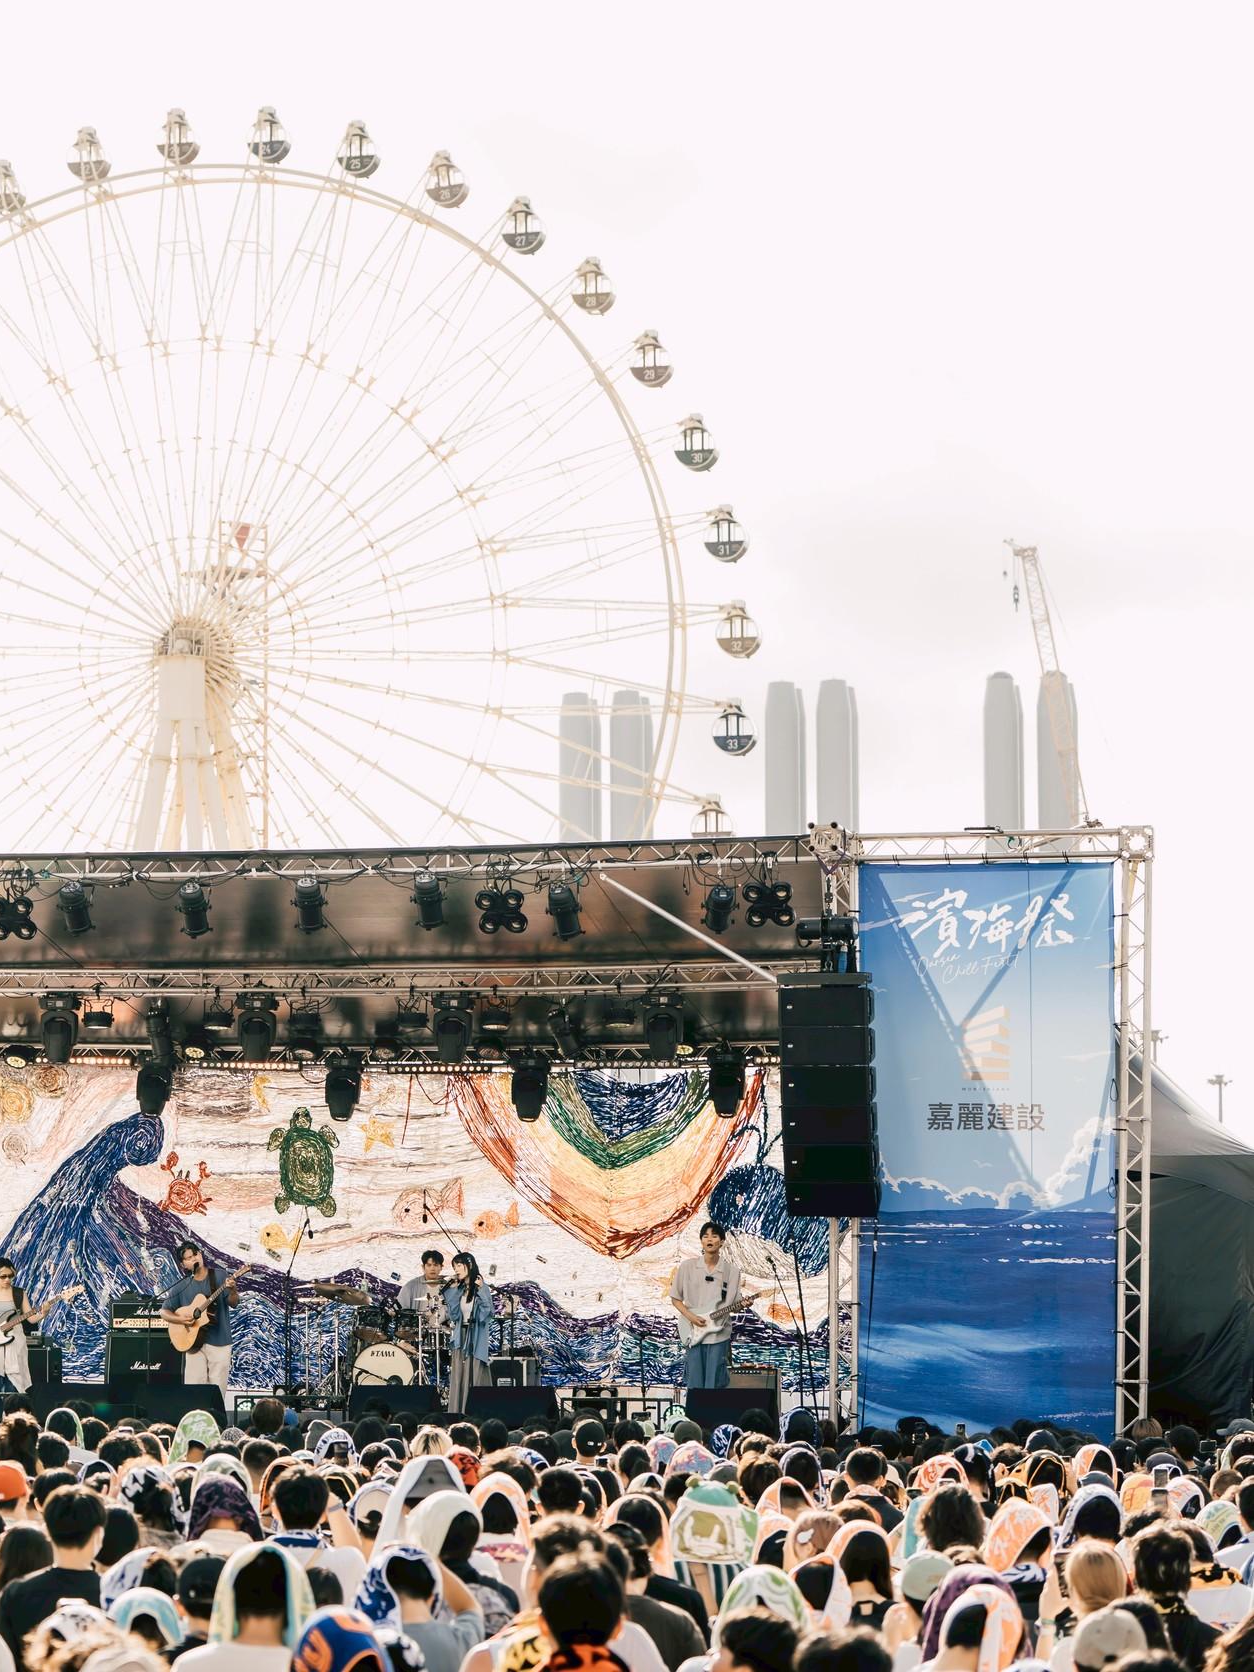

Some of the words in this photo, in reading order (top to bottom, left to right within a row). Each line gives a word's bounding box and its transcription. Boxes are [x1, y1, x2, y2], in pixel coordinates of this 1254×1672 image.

[350, 159, 360, 169] 25
[515, 235, 526, 245] 27
[643, 369, 655, 379] 29
[691, 453, 702, 463] 30
[718, 545, 729, 555] 31
[731, 641, 742, 651] 32
[727, 739, 738, 749] 33
[927, 1102, 1045, 1131] 嘉麗建設
[376, 1350, 395, 1358] TAMA
